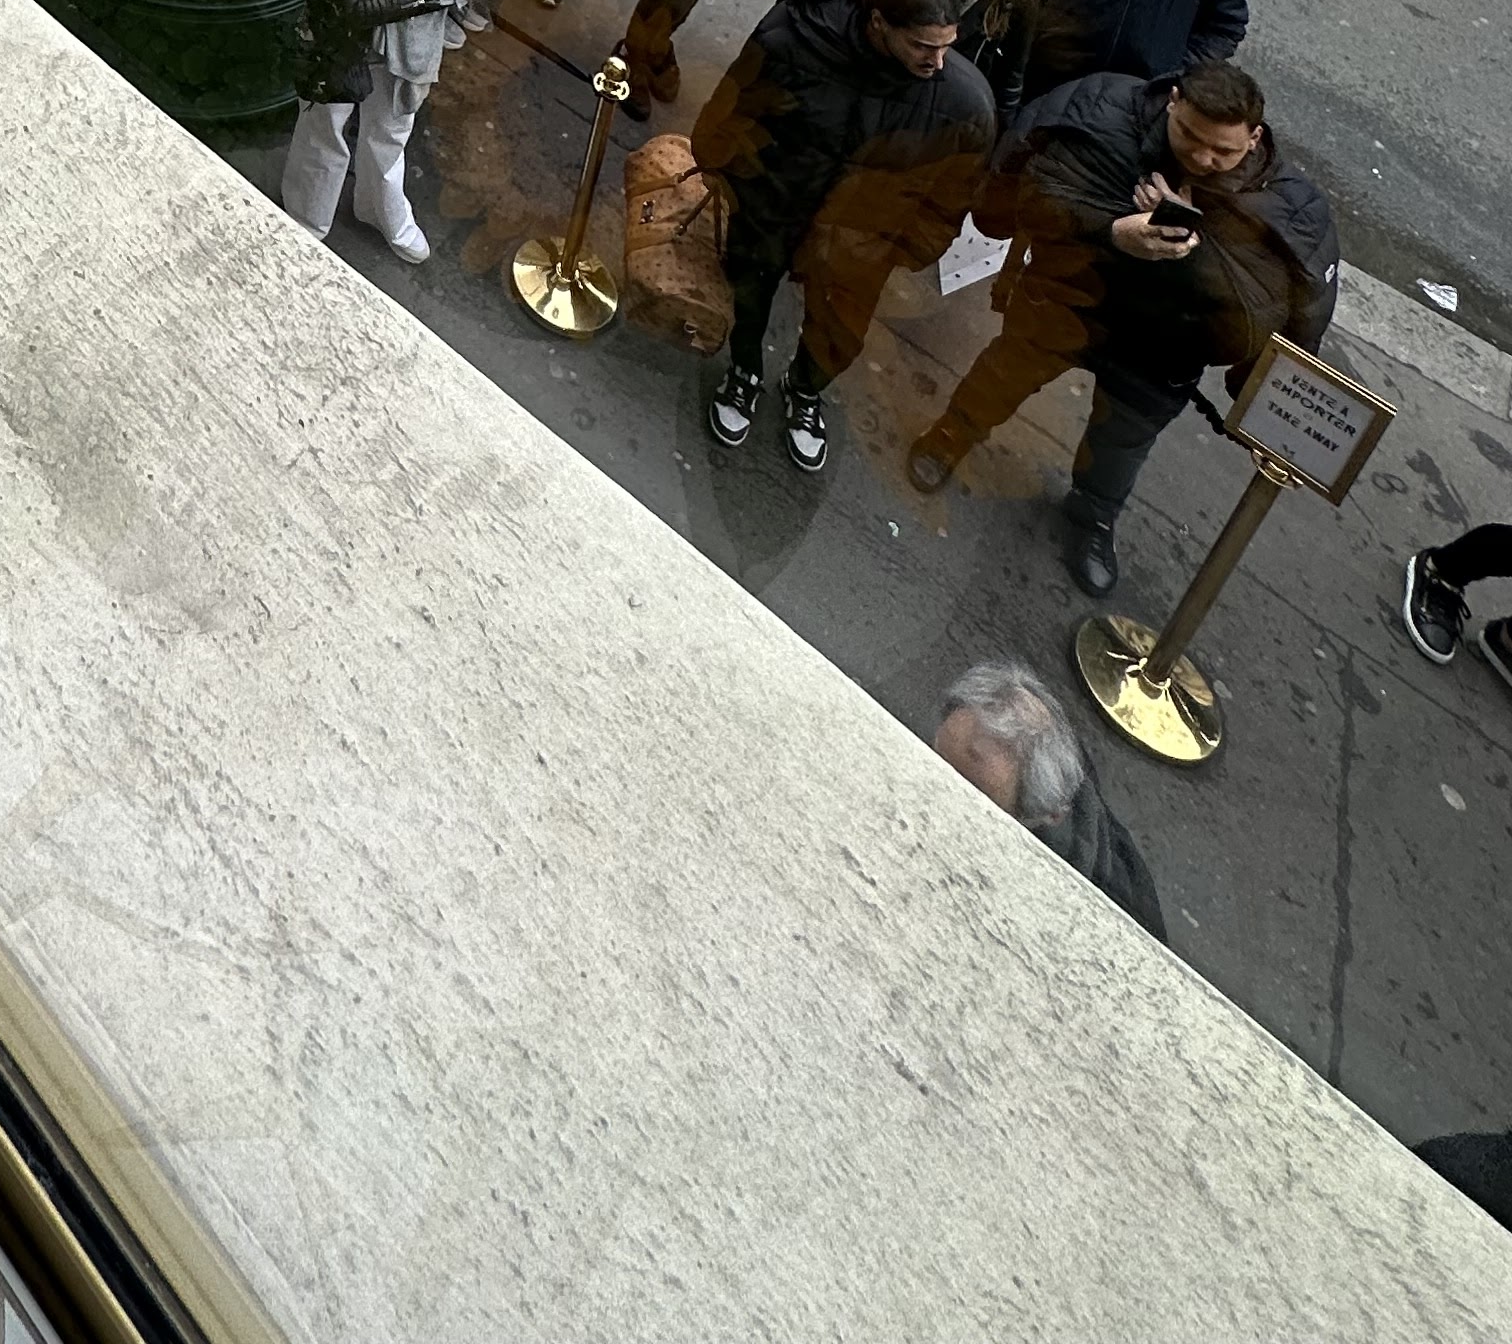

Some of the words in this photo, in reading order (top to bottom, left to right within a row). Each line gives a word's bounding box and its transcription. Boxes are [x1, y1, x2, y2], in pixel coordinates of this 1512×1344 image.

[1267, 400, 1301, 428] TAKE
[1303, 426, 1340, 452] AWAY
[1271, 377, 1356, 438] EMPORTER
